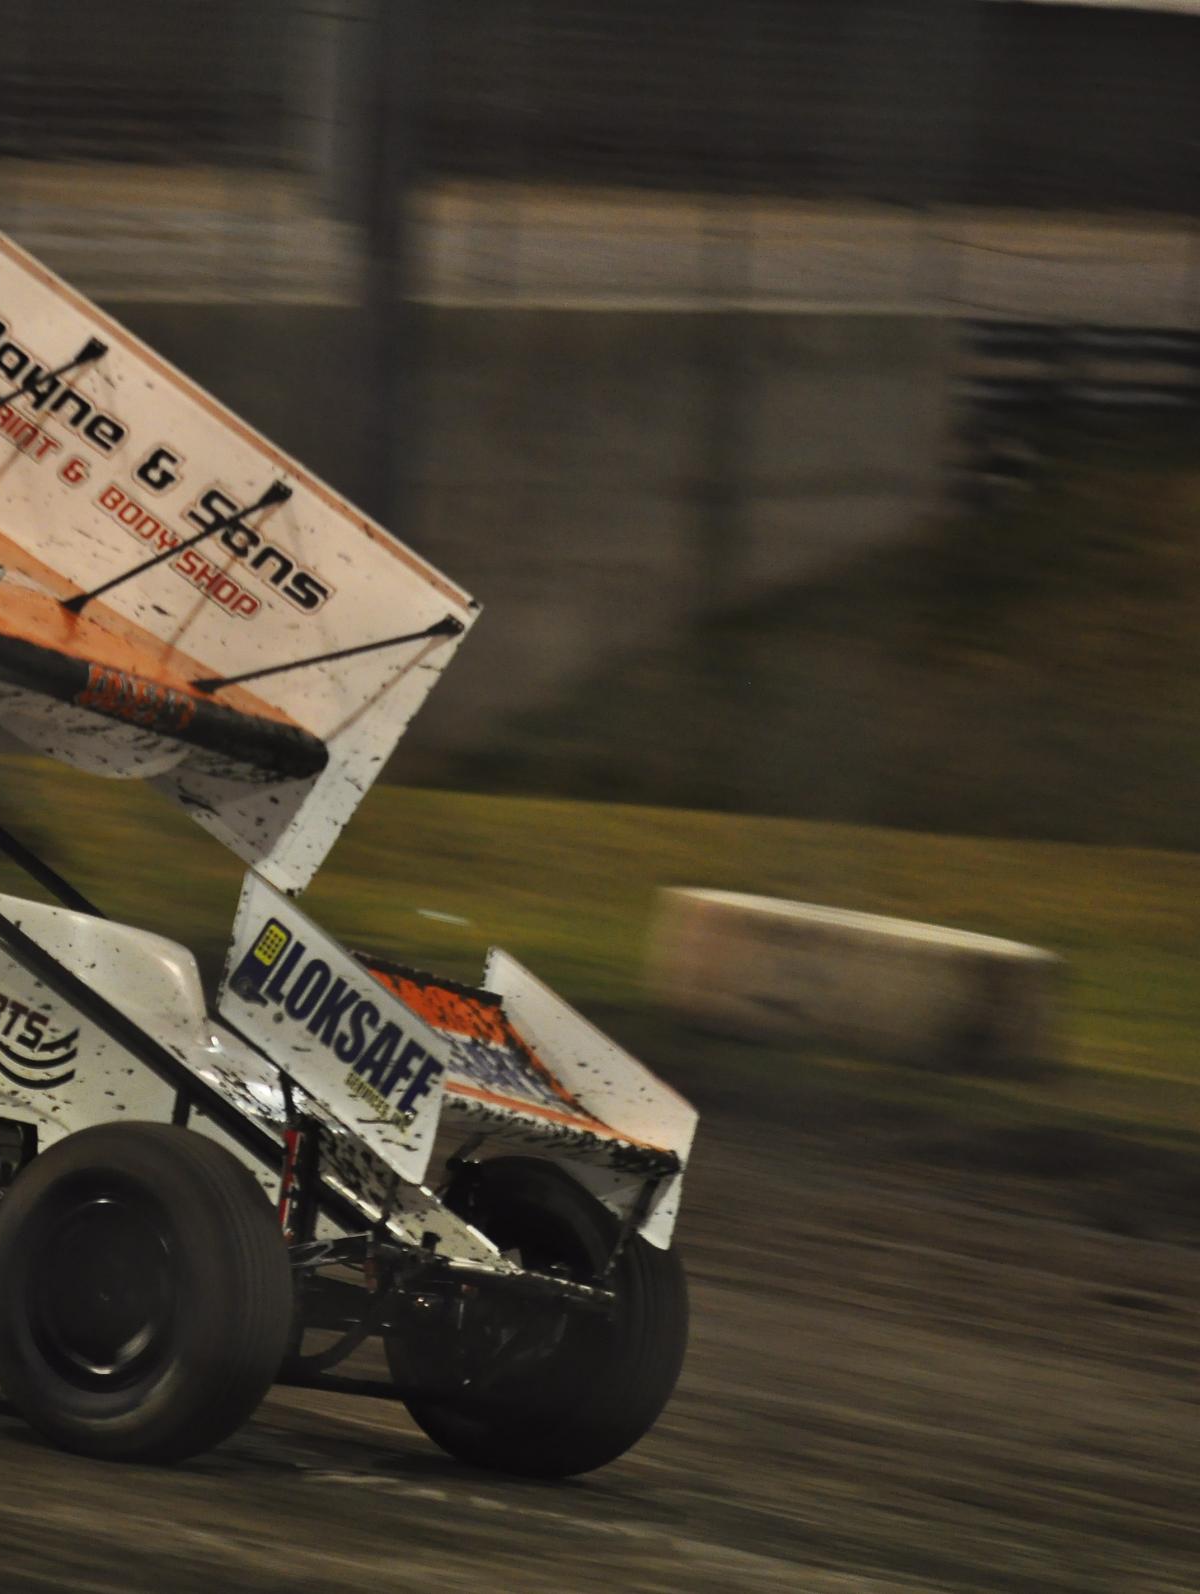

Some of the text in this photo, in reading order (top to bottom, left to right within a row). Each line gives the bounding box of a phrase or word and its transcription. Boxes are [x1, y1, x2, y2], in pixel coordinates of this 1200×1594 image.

[62, 459, 88, 483] &
[100, 486, 179, 551] BODY
[175, 550, 260, 617] SHOP
[137, 448, 179, 490] &
[188, 490, 330, 608] Sons
[268, 942, 444, 1112] LOKSAFE
